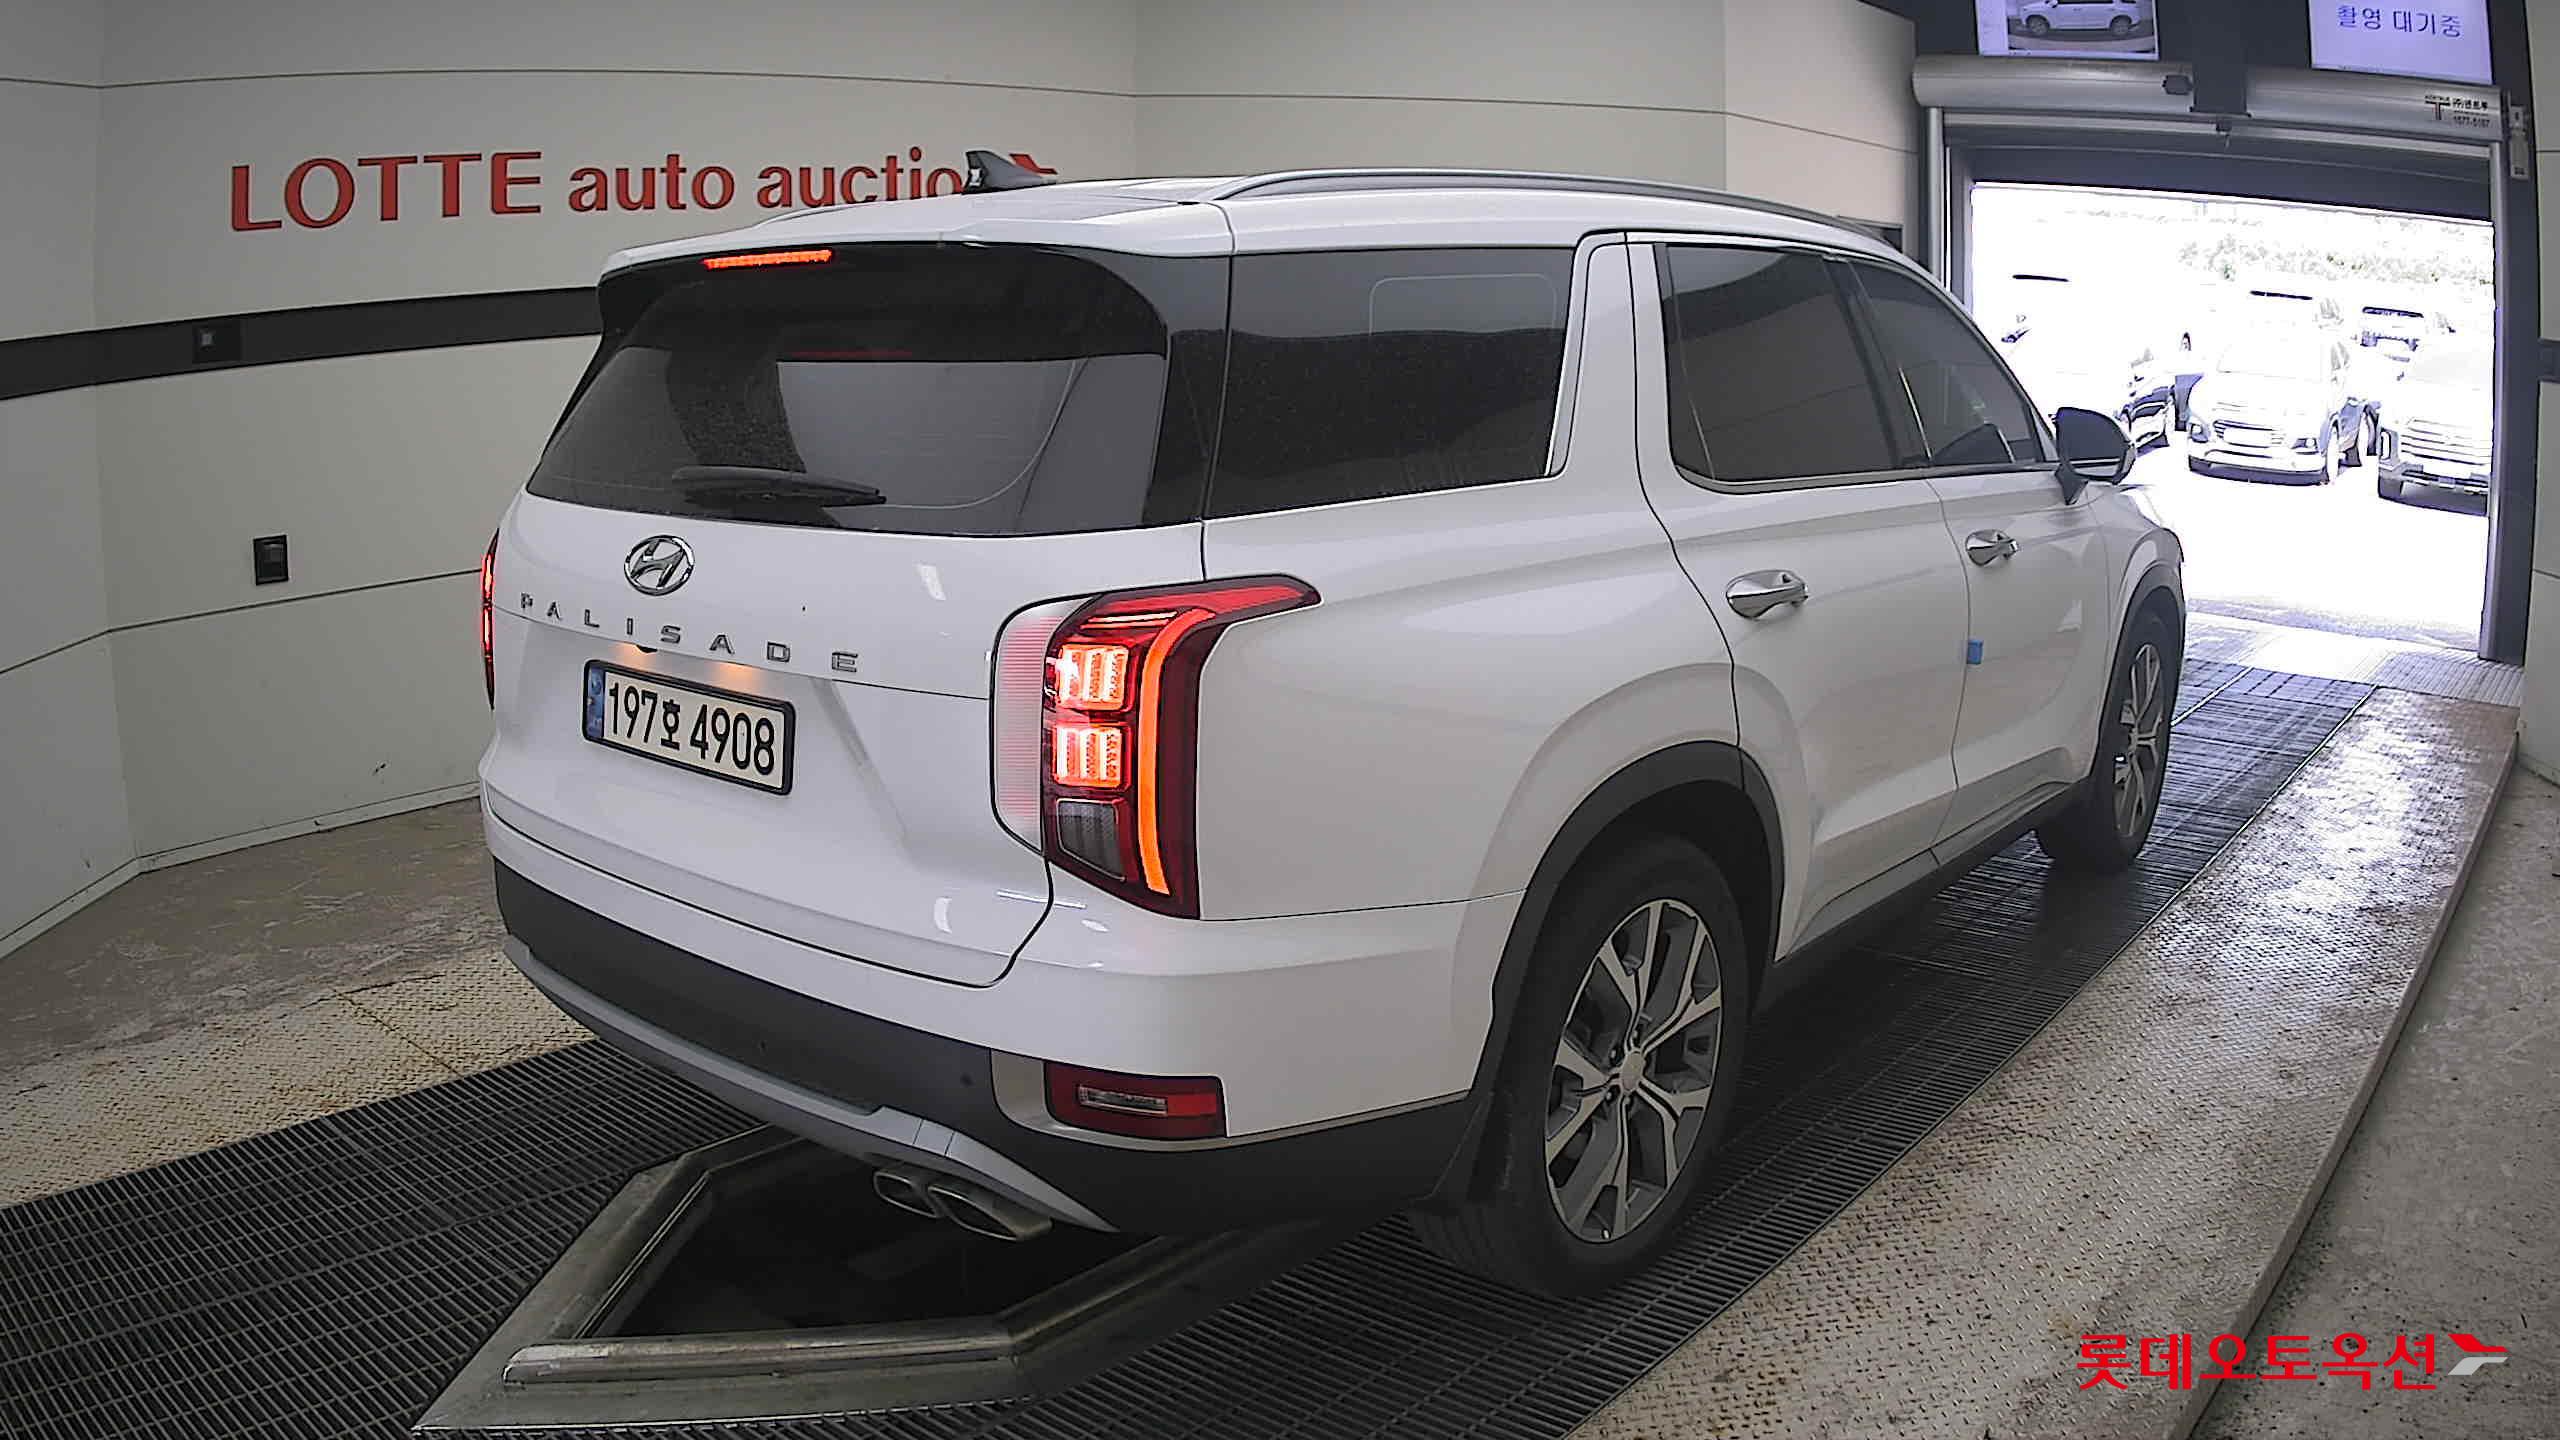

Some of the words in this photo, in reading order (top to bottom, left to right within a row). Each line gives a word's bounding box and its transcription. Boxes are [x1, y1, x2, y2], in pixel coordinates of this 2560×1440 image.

[2338, 5, 2382, 31] 촬영
[2392, 10, 2462, 38] 대기중
[231, 151, 542, 232] LOTTE
[568, 153, 736, 212] auto
[757, 146, 963, 208] auctio
[520, 592, 859, 673] PALISADE
[608, 682, 681, 751] 197호
[690, 703, 776, 776] 4908
